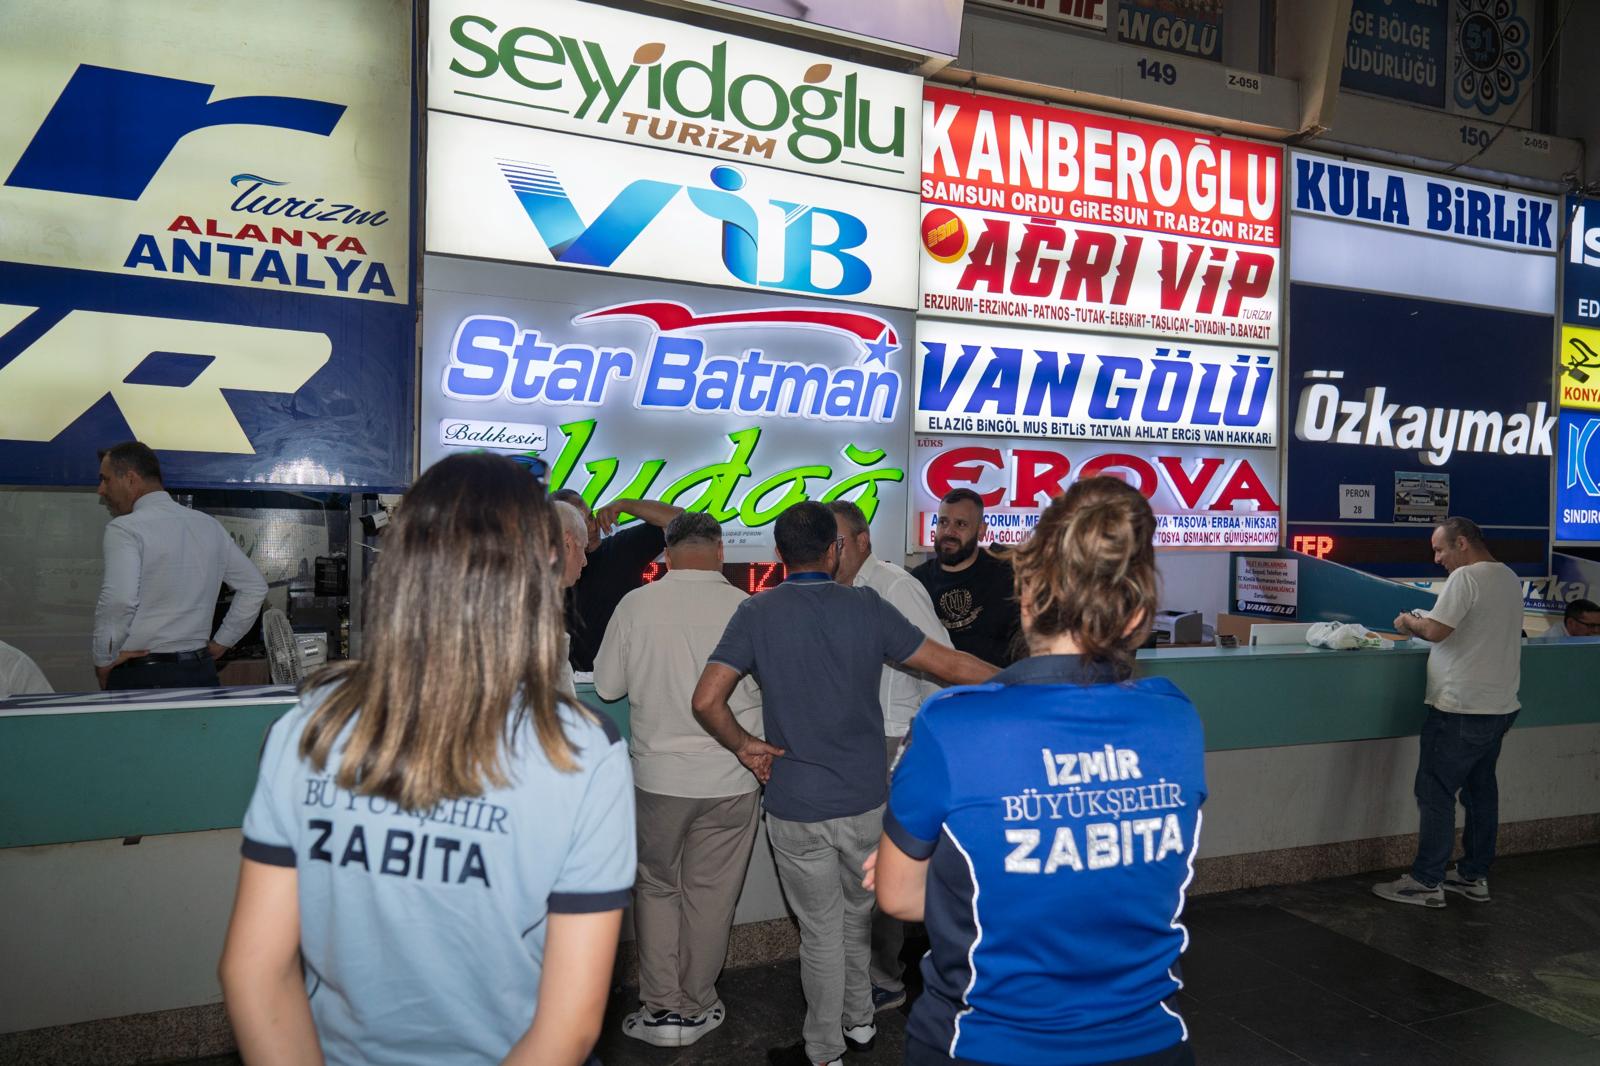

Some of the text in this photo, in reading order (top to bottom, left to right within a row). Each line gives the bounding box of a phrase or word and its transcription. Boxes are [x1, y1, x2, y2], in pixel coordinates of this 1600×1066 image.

[1350, 10, 1430, 50] GE BÖLGE
[1136, 58, 1177, 85] 149
[1228, 75, 1259, 90] Z-058
[1460, 125, 1489, 147] 150
[922, 99, 1277, 221] KANBEROĞLU
[230, 173, 390, 227] Turizm
[921, 179, 1005, 209] SAMSUN
[1011, 192, 1064, 215] ORDU
[1153, 210, 1233, 238] TRABZON
[1296, 158, 1410, 226] KULA
[167, 215, 368, 255] ALANYA
[123, 233, 396, 297] ANTALYA
[956, 217, 1143, 306] AĞRI
[446, 316, 900, 421] Star Batman
[444, 423, 545, 446] Balıkesir
[928, 415, 973, 431] ELAZIĞ
[1023, 421, 1048, 437] MUŞ
[1090, 424, 1131, 438] TATVAN
[1135, 426, 1168, 440] AHLAT
[1204, 429, 1224, 442] VAN
[1298, 370, 1557, 466] Özkaymak
[917, 438, 943, 447] LÜKS
[465, 418, 904, 528] ludağ
[1345, 489, 1370, 498] PERON
[1212, 517, 1240, 528] ERBAA
[1353, 505, 1362, 514] 28
[1183, 531, 1221, 543] OSMANCIK
[1042, 743, 1143, 787] İZMİR
[1001, 777, 1186, 820] BÜYÜKŞEHİR
[308, 819, 491, 888] ZABITA
[1004, 813, 1184, 874] ZABITA
